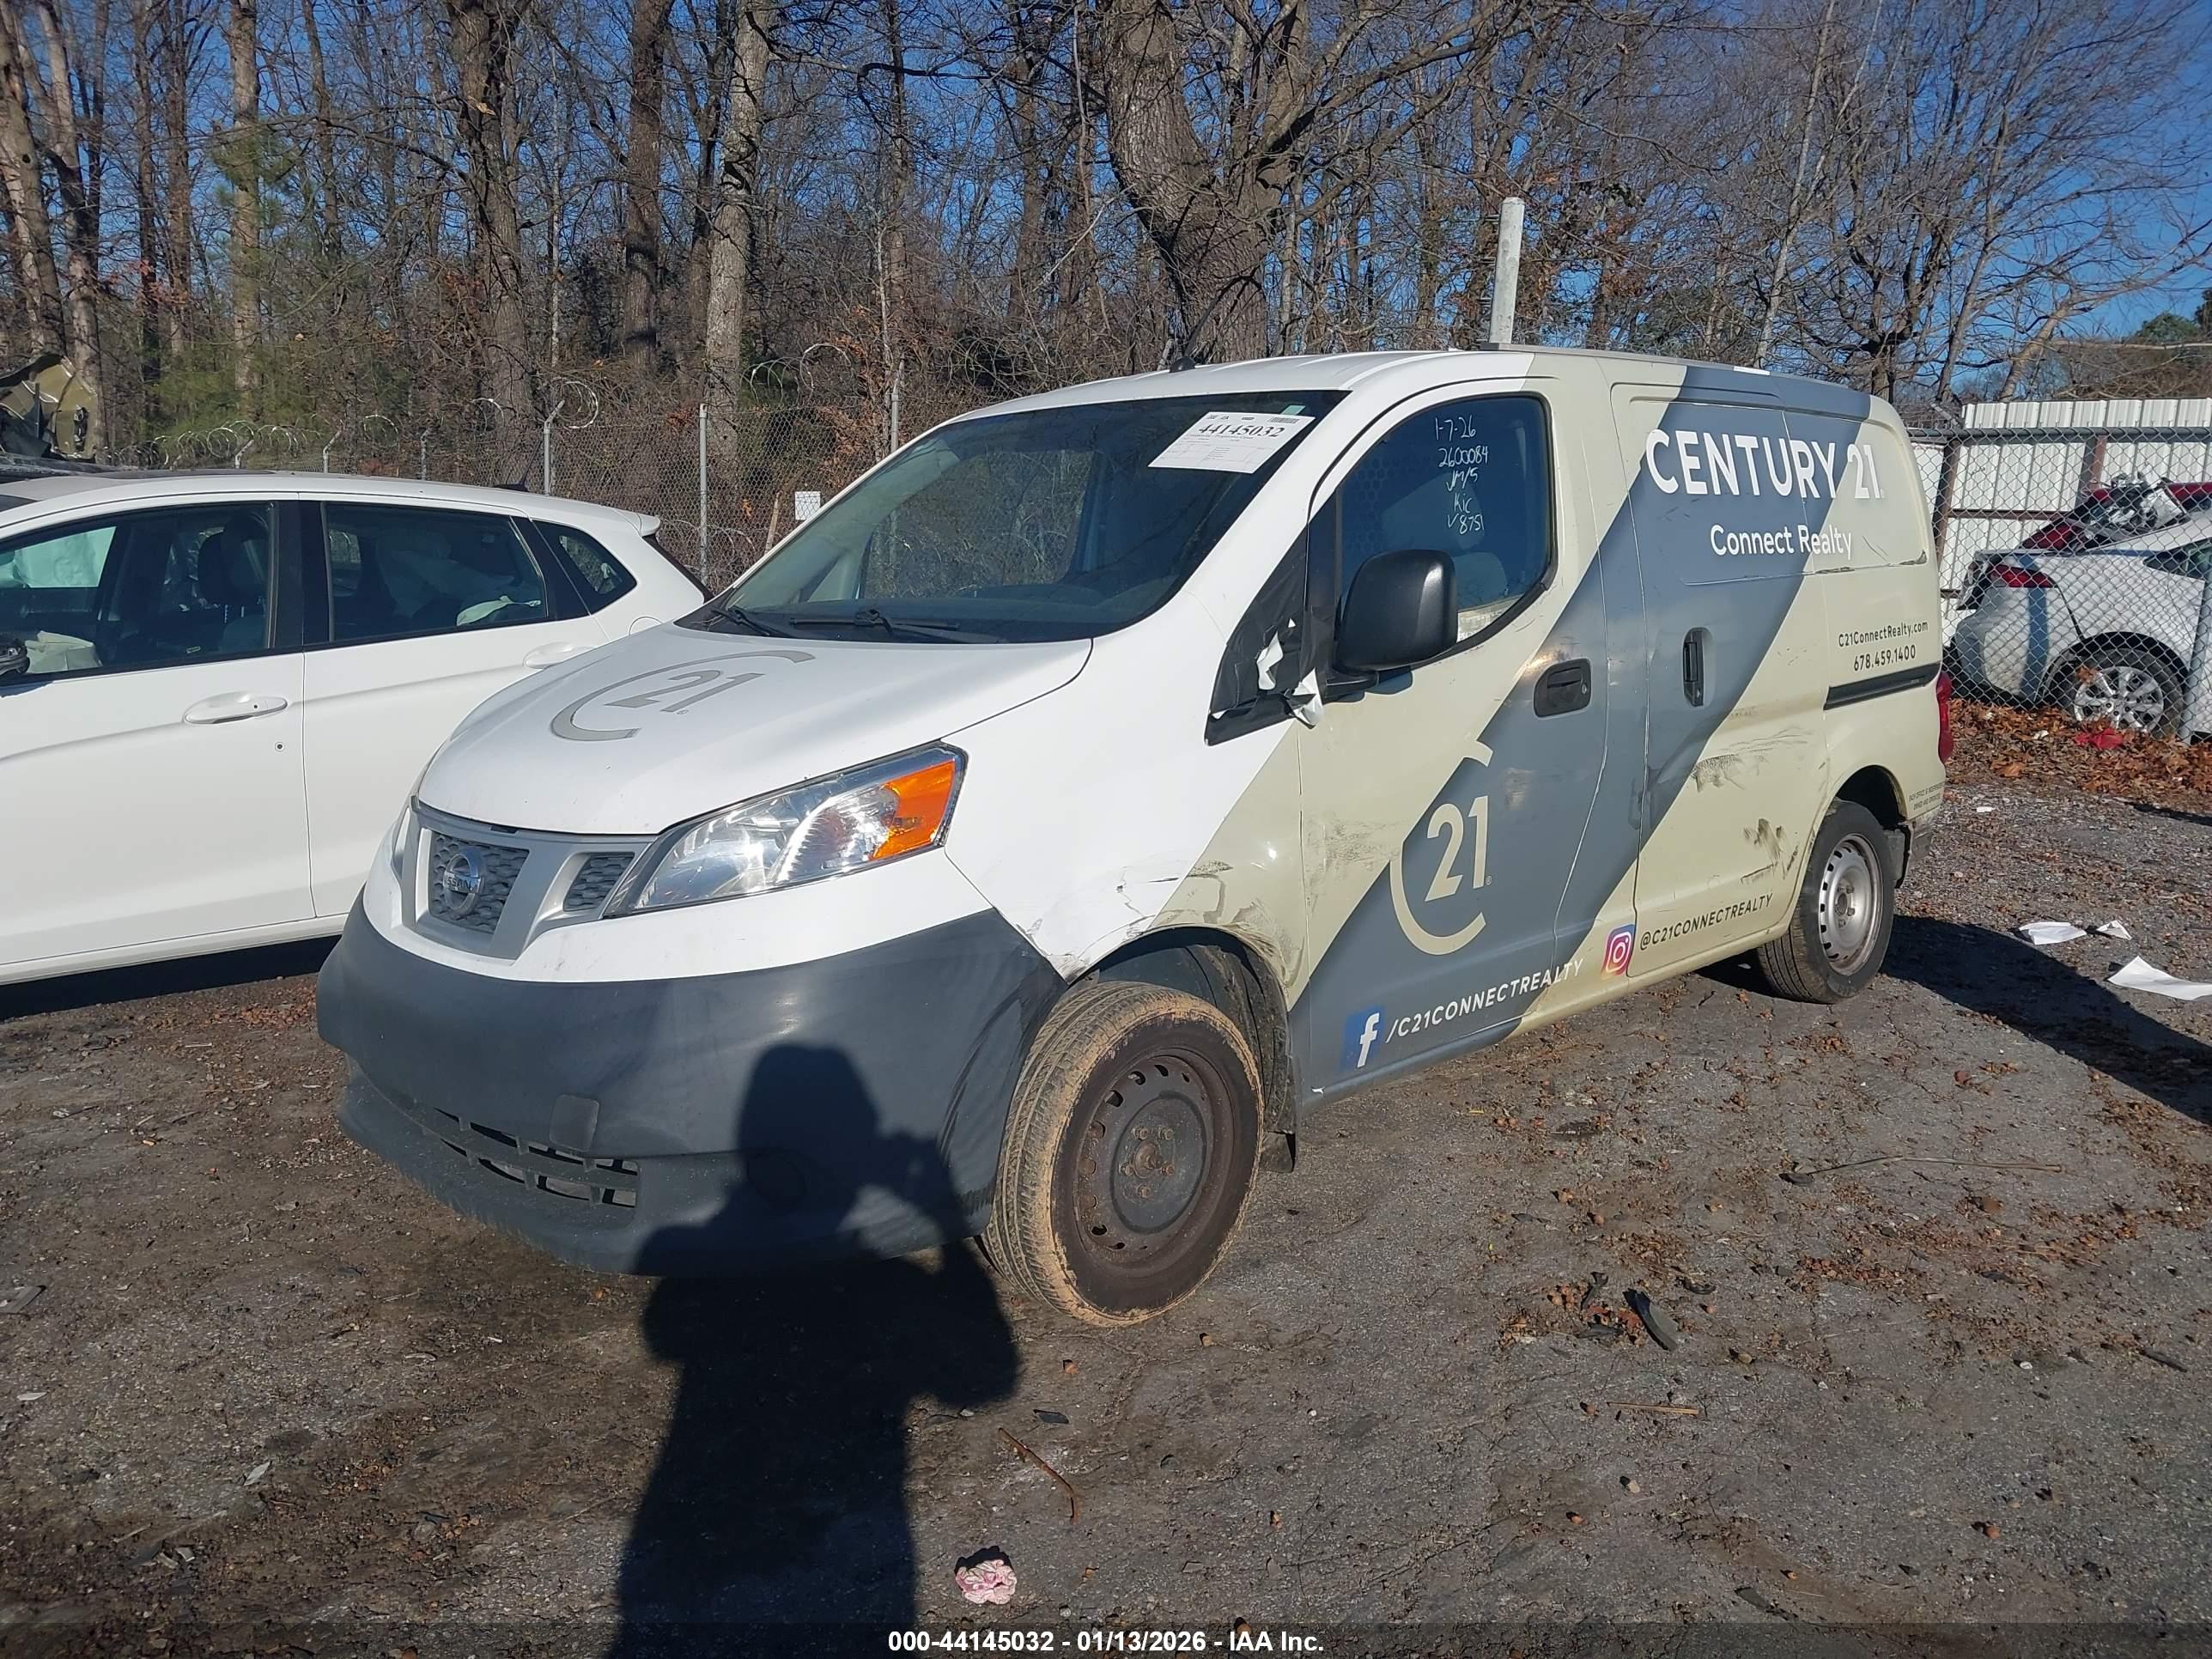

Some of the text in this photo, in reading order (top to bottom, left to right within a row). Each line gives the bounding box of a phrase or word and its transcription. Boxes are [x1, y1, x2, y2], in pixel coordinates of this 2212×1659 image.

[1199, 422, 1285, 439] 44145032
[1645, 428, 1837, 499] CENTURY
[1710, 524, 1853, 560] Connect Realty
[1838, 621, 1929, 647] C21ConnectRealty.com
[1853, 644, 1917, 672] 678.459.1400
[1639, 892, 1774, 951] @C21CONNECTREALTY
[1384, 957, 1583, 1044] /C21CONNECTREALTY
